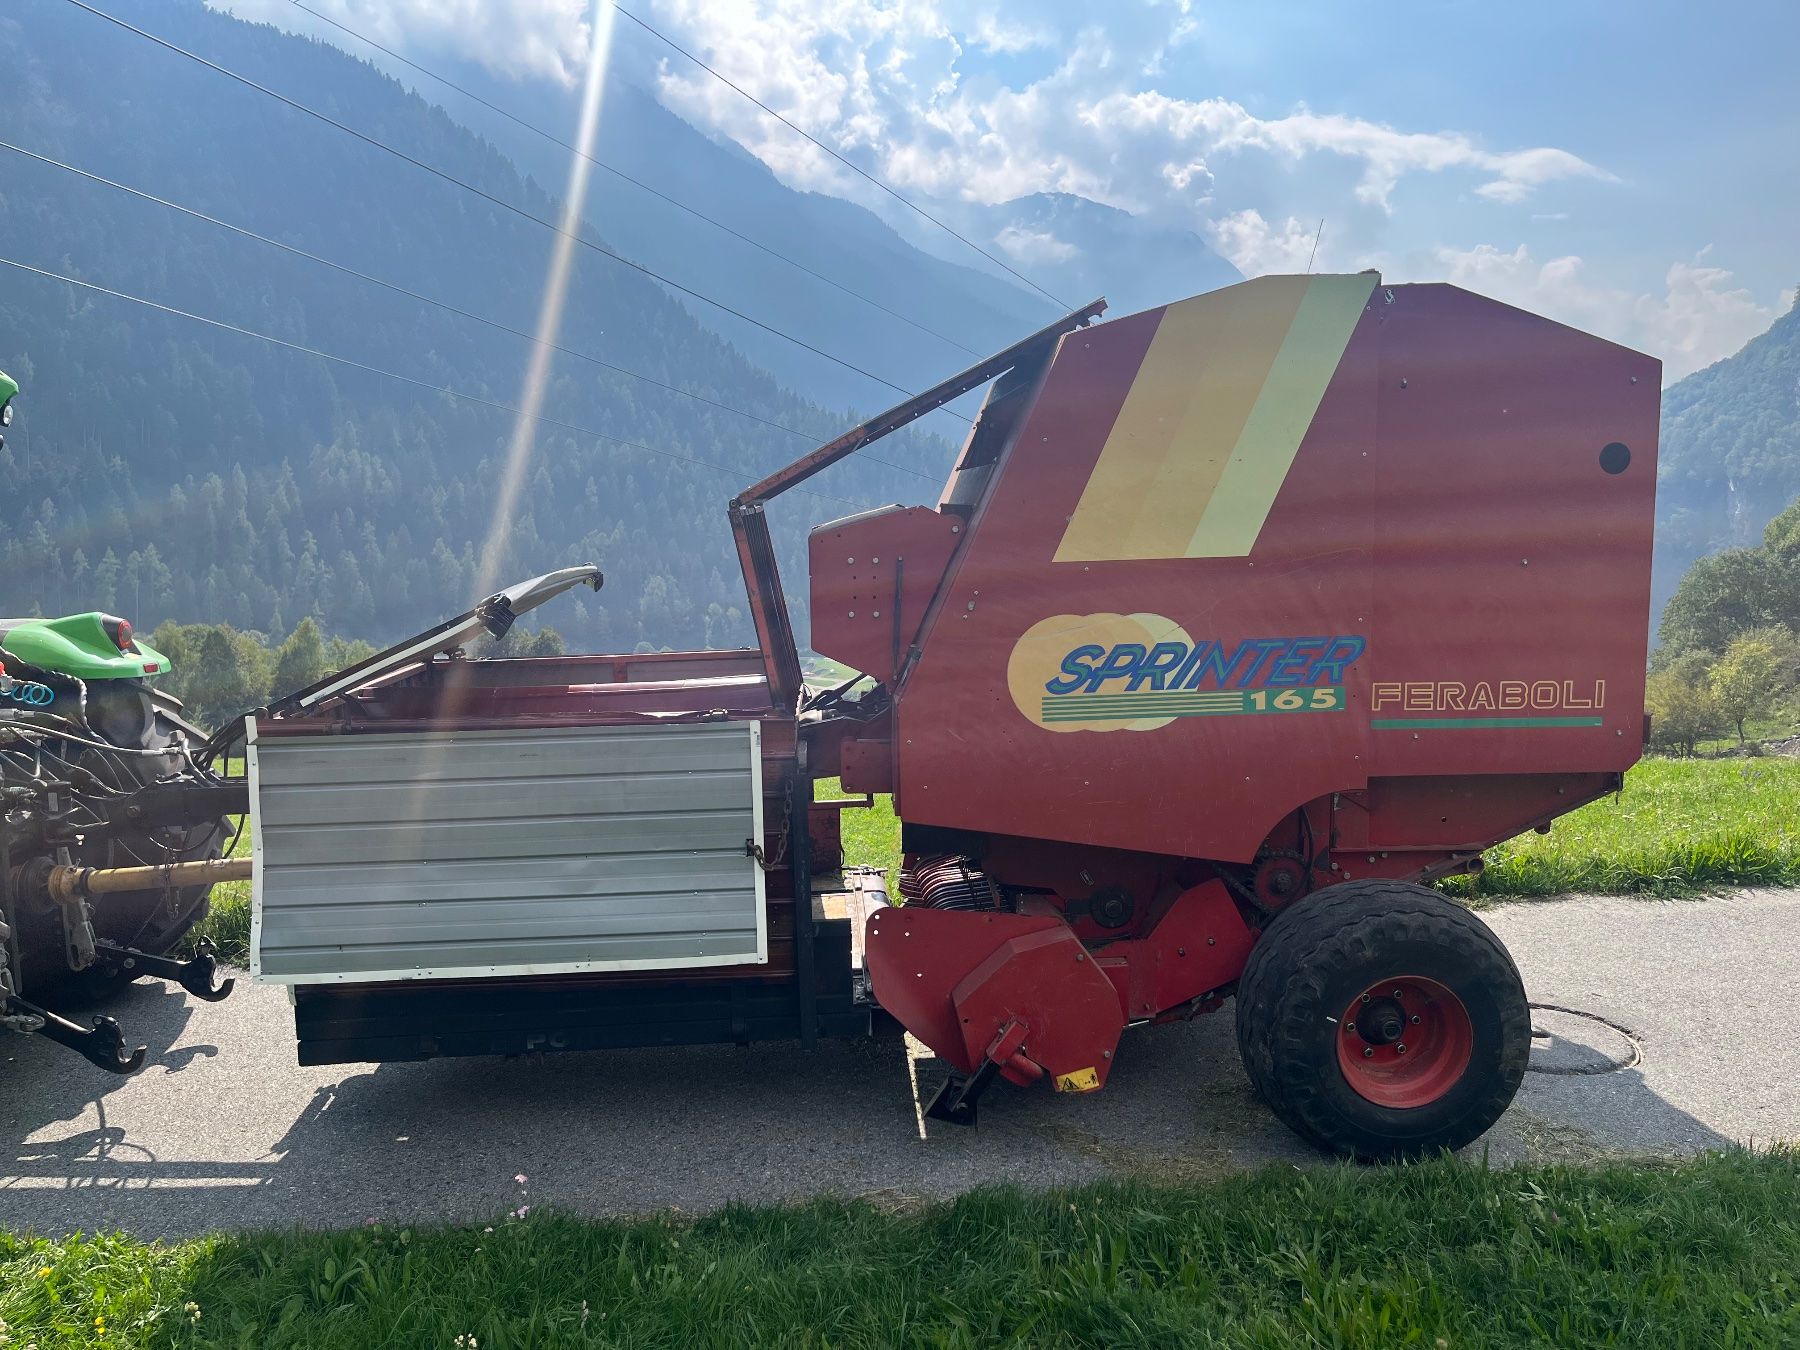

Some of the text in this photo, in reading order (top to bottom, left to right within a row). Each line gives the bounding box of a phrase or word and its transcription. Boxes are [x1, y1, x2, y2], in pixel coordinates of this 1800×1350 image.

[1045, 635, 1367, 695] SPRINTER
[1250, 688, 1338, 711] 165
[1372, 680, 1605, 711] FERABOLI
